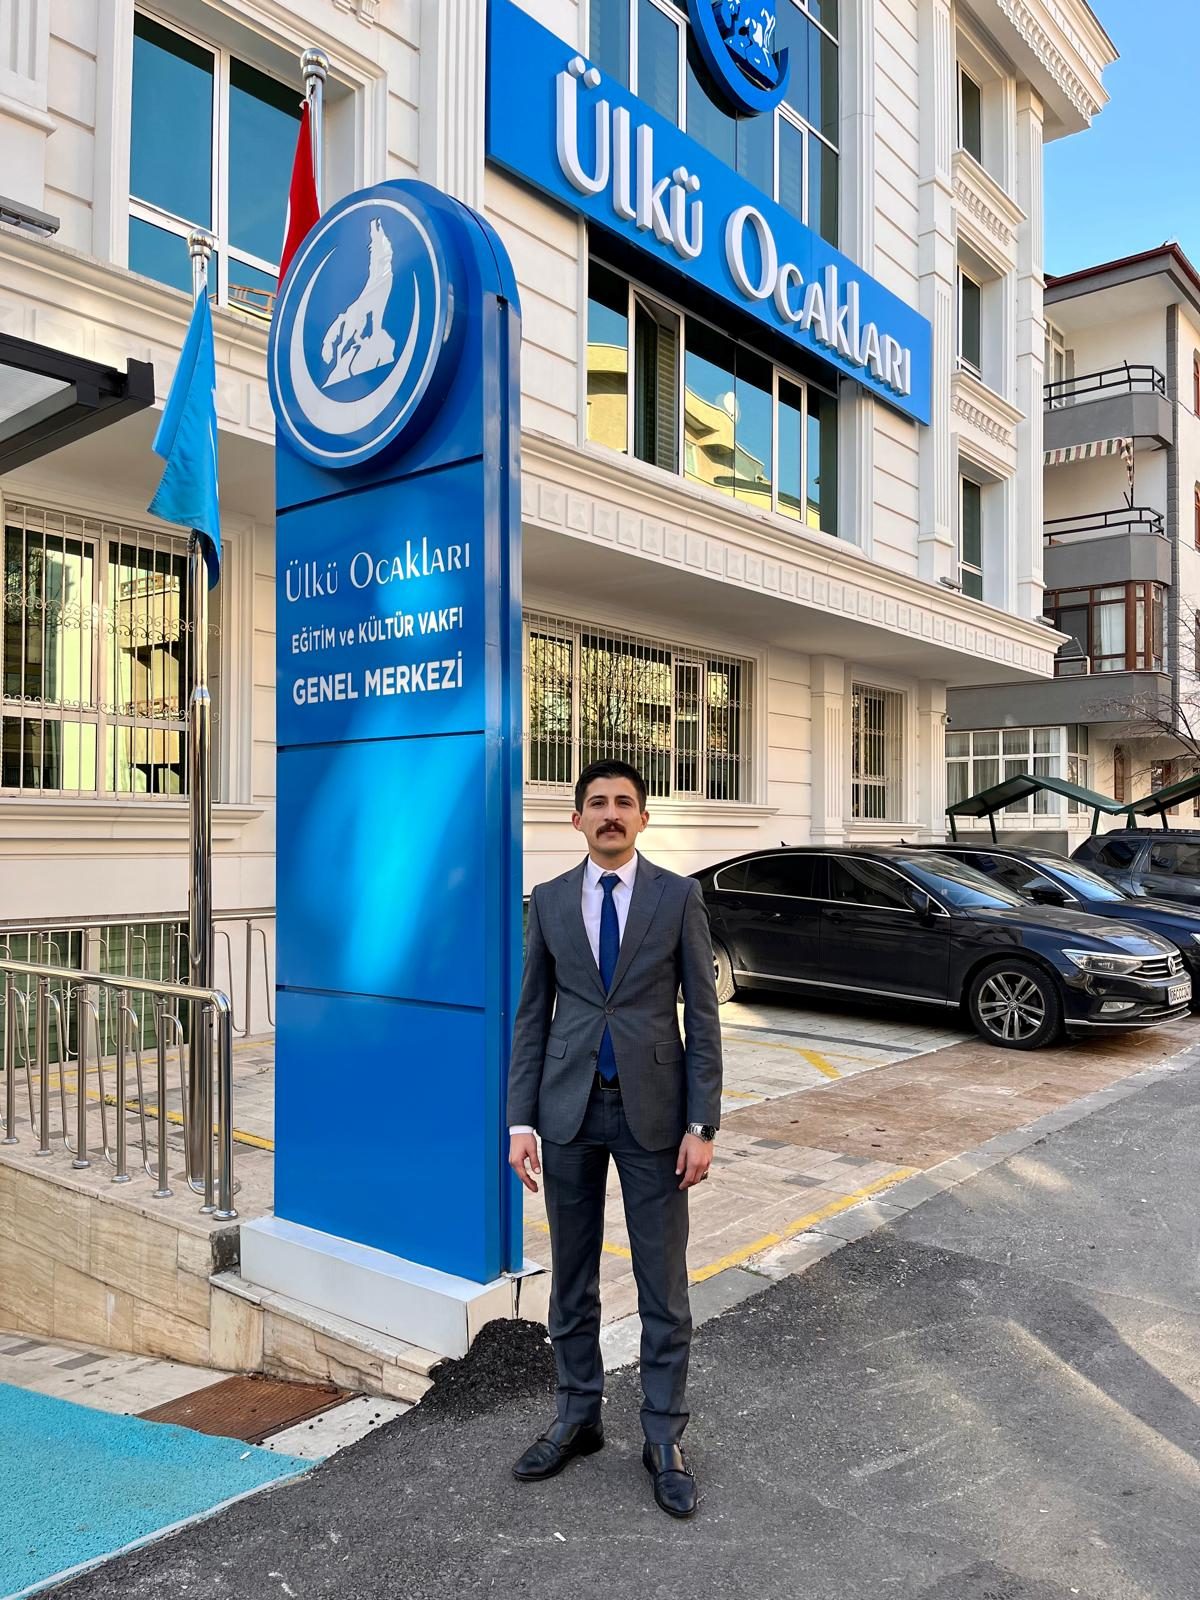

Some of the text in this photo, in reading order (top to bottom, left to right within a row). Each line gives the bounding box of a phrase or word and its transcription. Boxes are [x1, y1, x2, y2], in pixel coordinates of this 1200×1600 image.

[556, 55, 703, 259] Ülkü
[286, 559, 338, 602] Ülkü
[292, 606, 463, 654] EĞİTİM ve KÜLTÜR VAKFI
[292, 650, 463, 706] GENEL MERKEZİ
